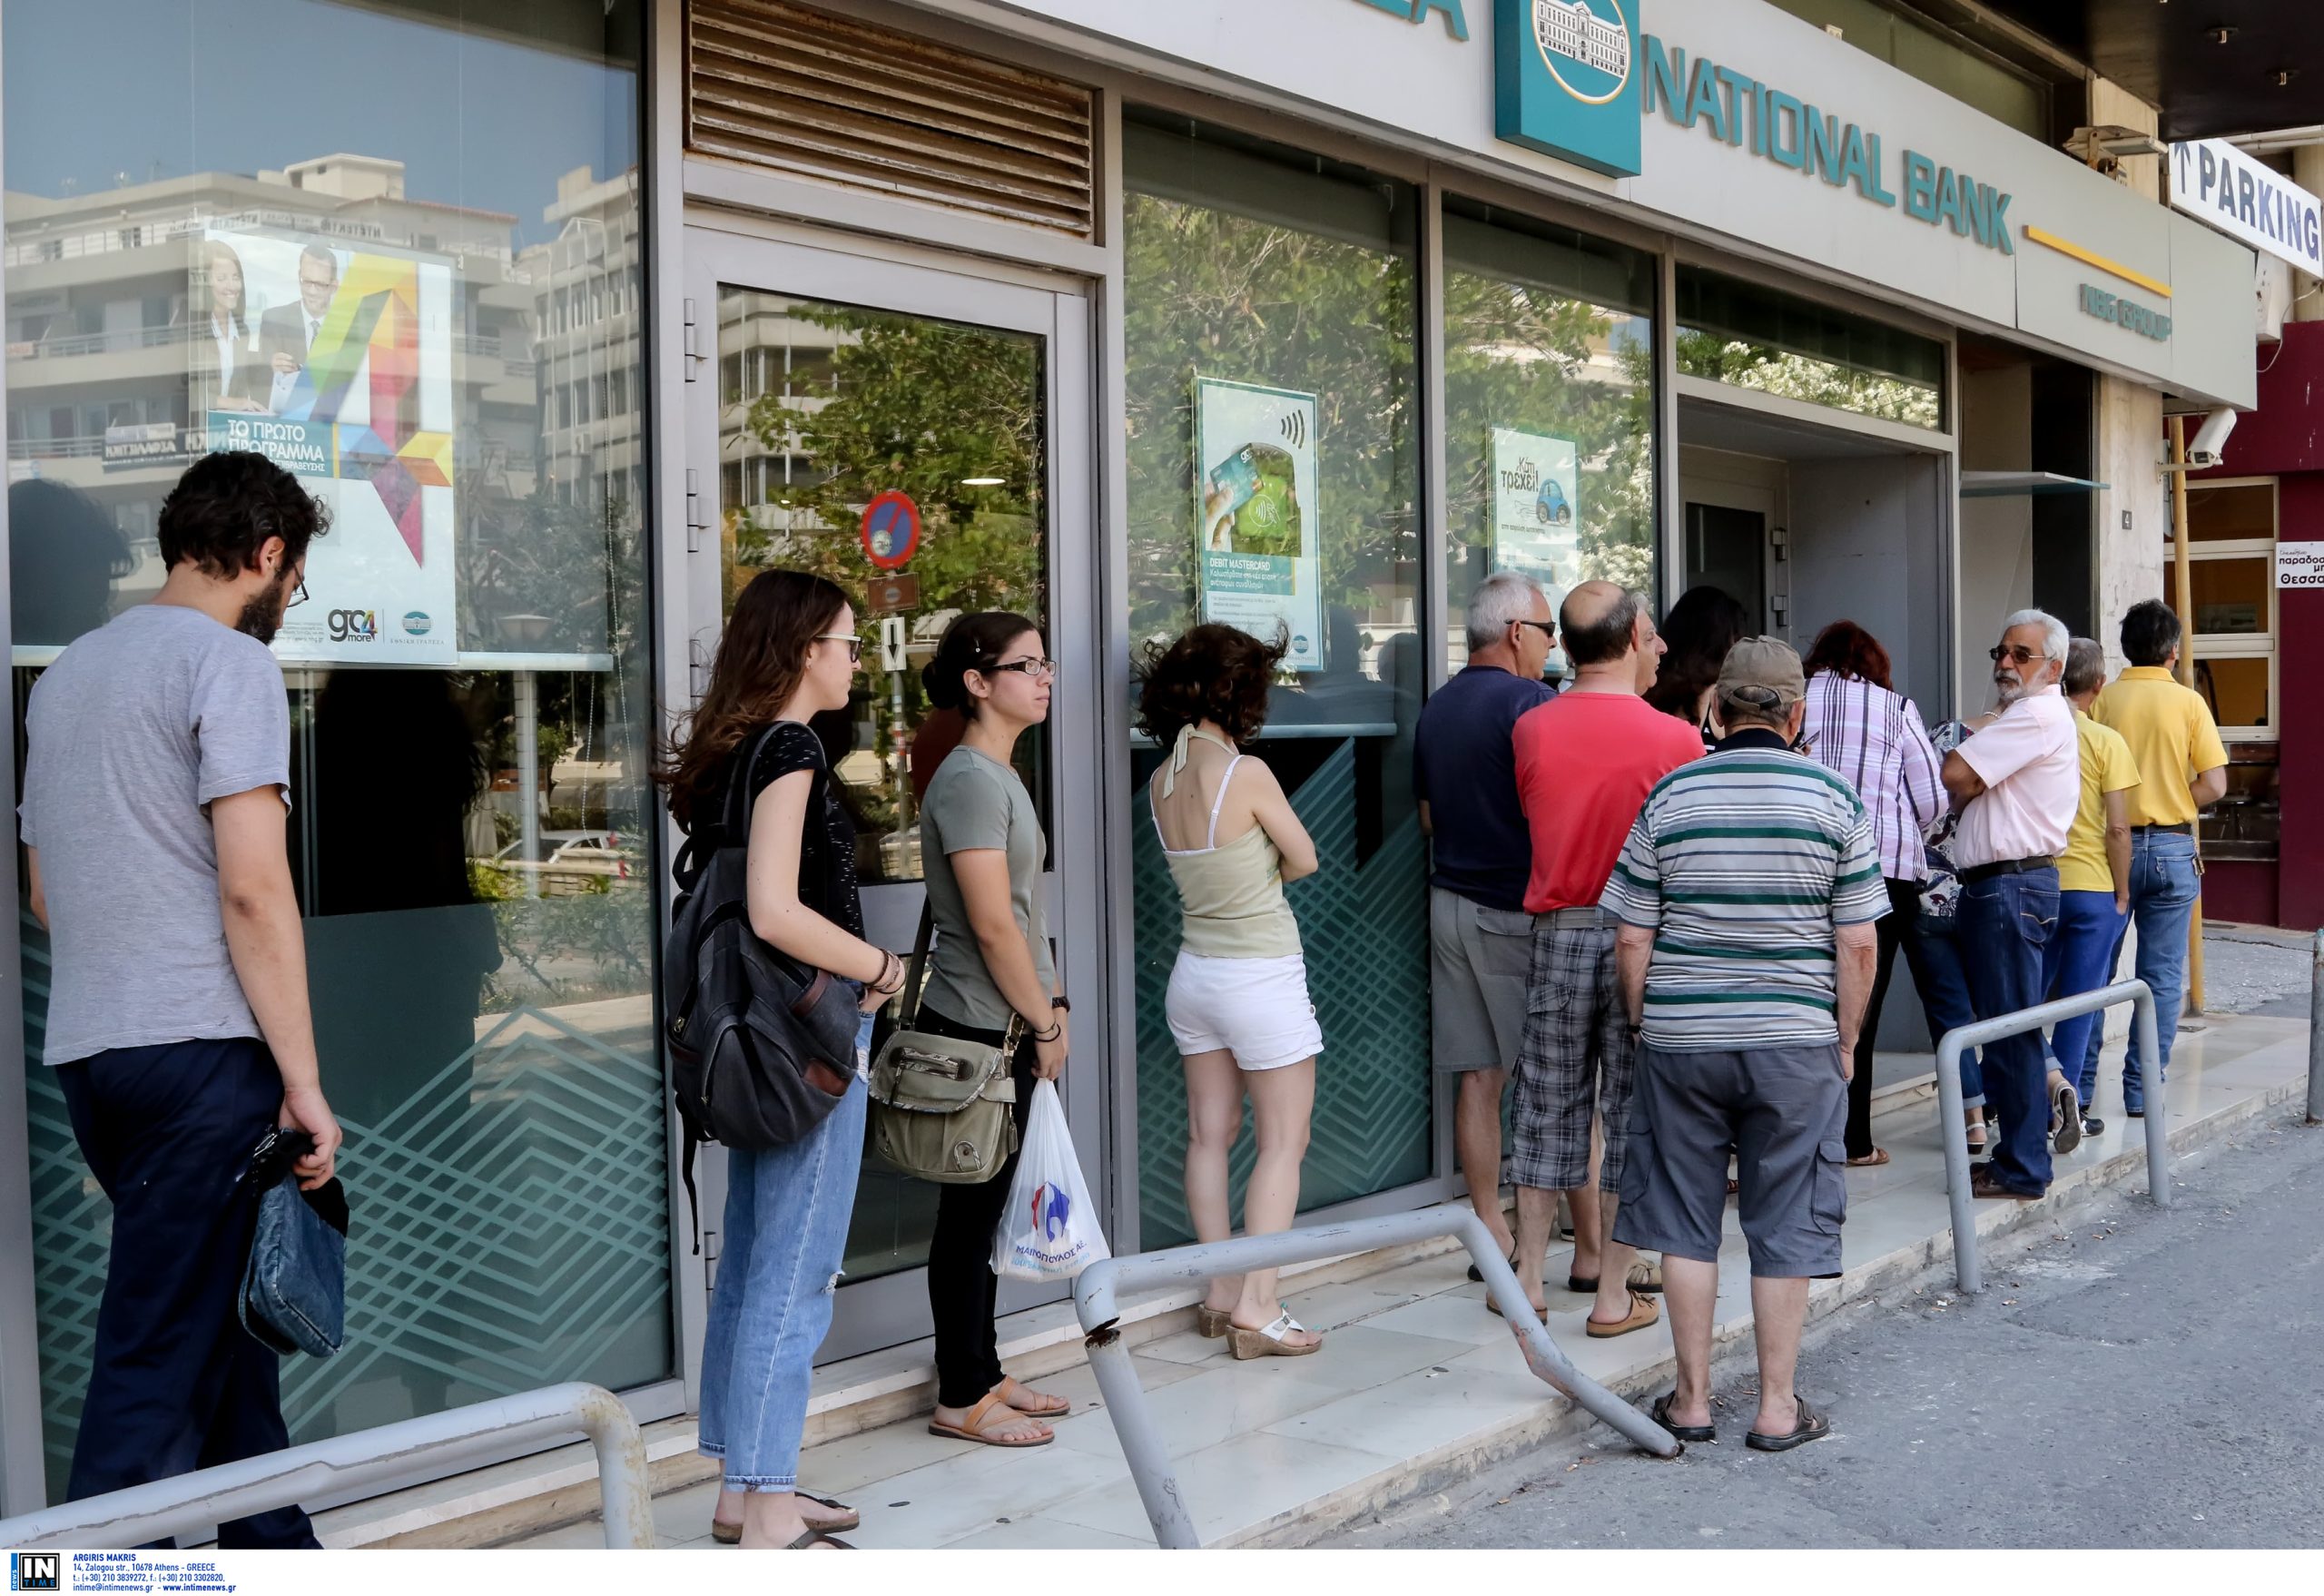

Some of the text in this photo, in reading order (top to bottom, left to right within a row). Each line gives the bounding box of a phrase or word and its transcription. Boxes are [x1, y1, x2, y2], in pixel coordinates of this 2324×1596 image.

[1641, 34, 2014, 256] NATIONAL BANK
[2199, 143, 2319, 261] PARKING
[2116, 299, 2172, 343] GROUP
[227, 419, 306, 442] ΤΟ ΠΡΩΤΟ
[229, 438, 325, 462] ΠΡΟΓΡΑΜΜΑ
[1209, 557, 1270, 571] DEBIT MASTERCARD
[348, 634, 371, 642] more
